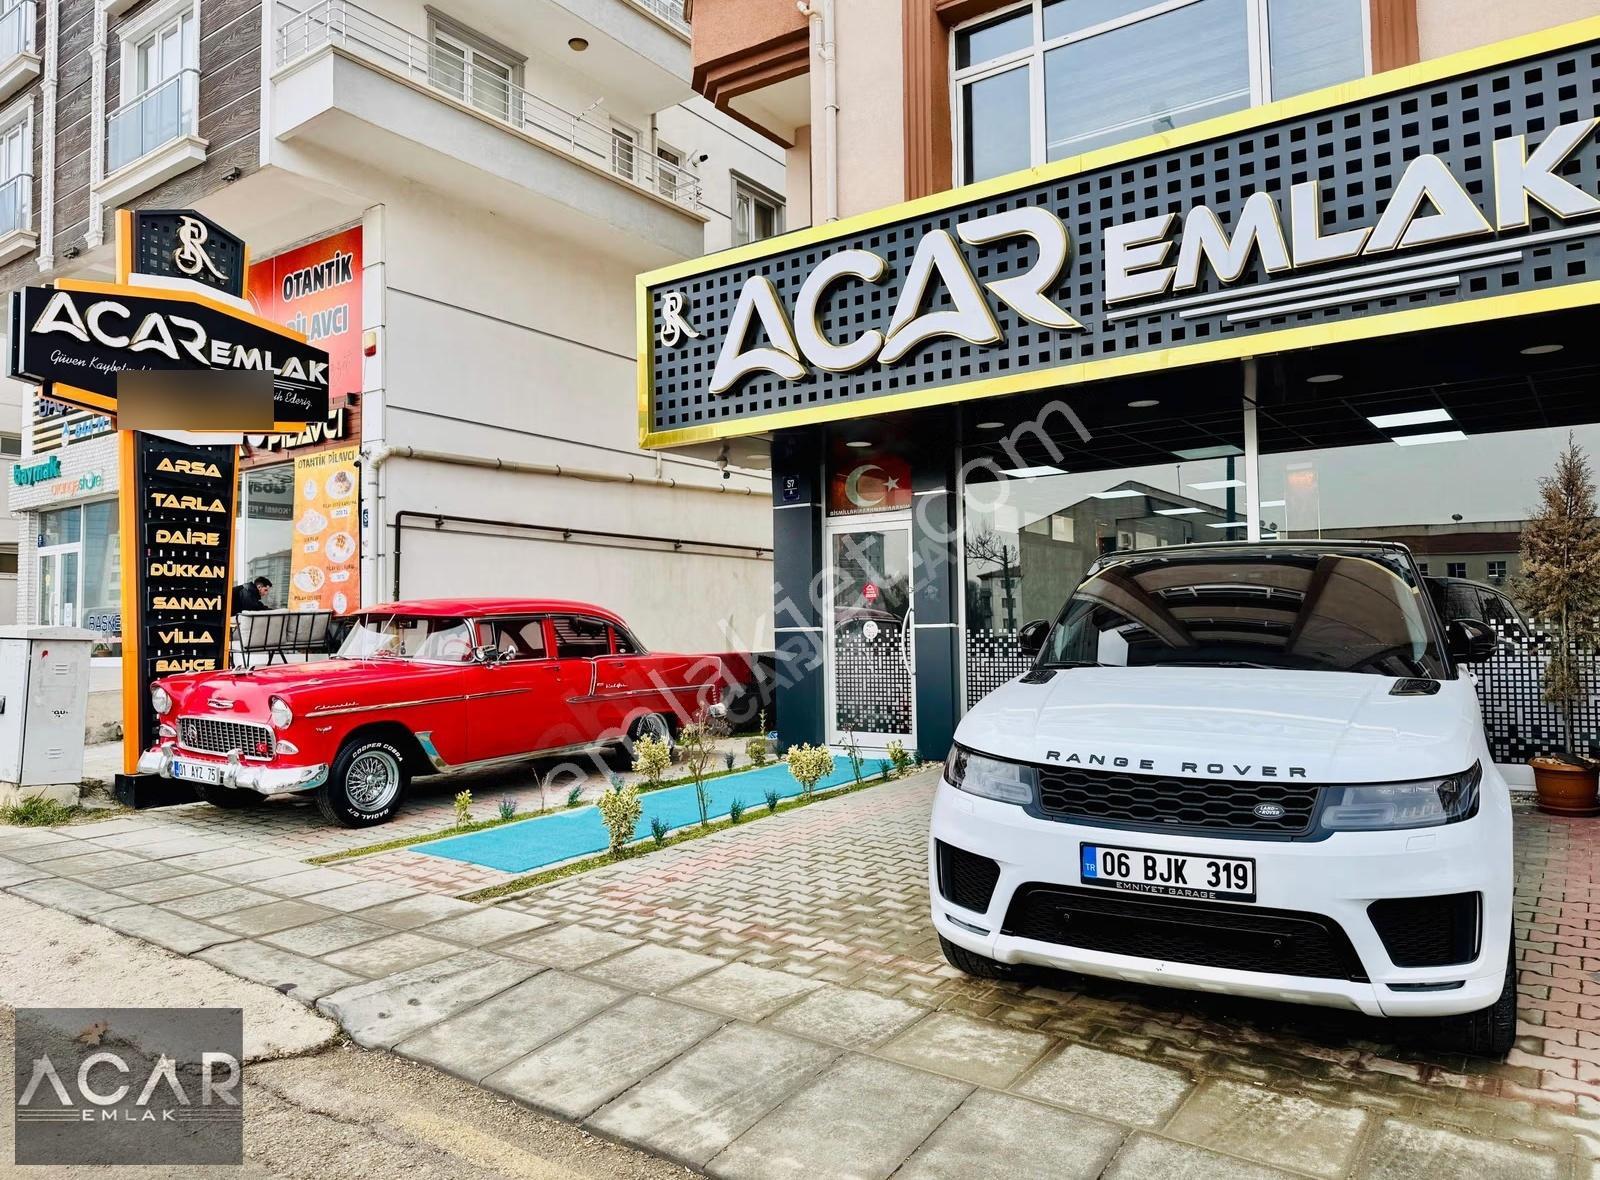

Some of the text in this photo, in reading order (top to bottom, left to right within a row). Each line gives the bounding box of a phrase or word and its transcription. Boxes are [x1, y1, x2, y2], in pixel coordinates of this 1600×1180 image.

[709, 116, 1600, 395] ACAR EMLAK
[282, 250, 353, 301] OTANTİK
[31, 292, 329, 386] ACAR EMLAK
[50, 349, 87, 366] Güven
[156, 457, 222, 478] ARSA
[298, 454, 326, 469] OTANTİK
[151, 492, 226, 513] TARLA
[155, 528, 220, 546] DAİRE
[150, 560, 225, 579] DÜKKAN
[152, 595, 222, 611] SANAYİ
[158, 628, 214, 644] VİLLA
[155, 658, 216, 673] BAHÇE
[352, 742, 403, 762] COOPER COBRA
[1046, 750, 1307, 778] RANGE ROVER
[207, 767, 216, 781] 75
[362, 808, 389, 820] RADIAL
[1085, 851, 1248, 890] TR 06 BJK 319
[1168, 888, 1217, 899] GARAGE
